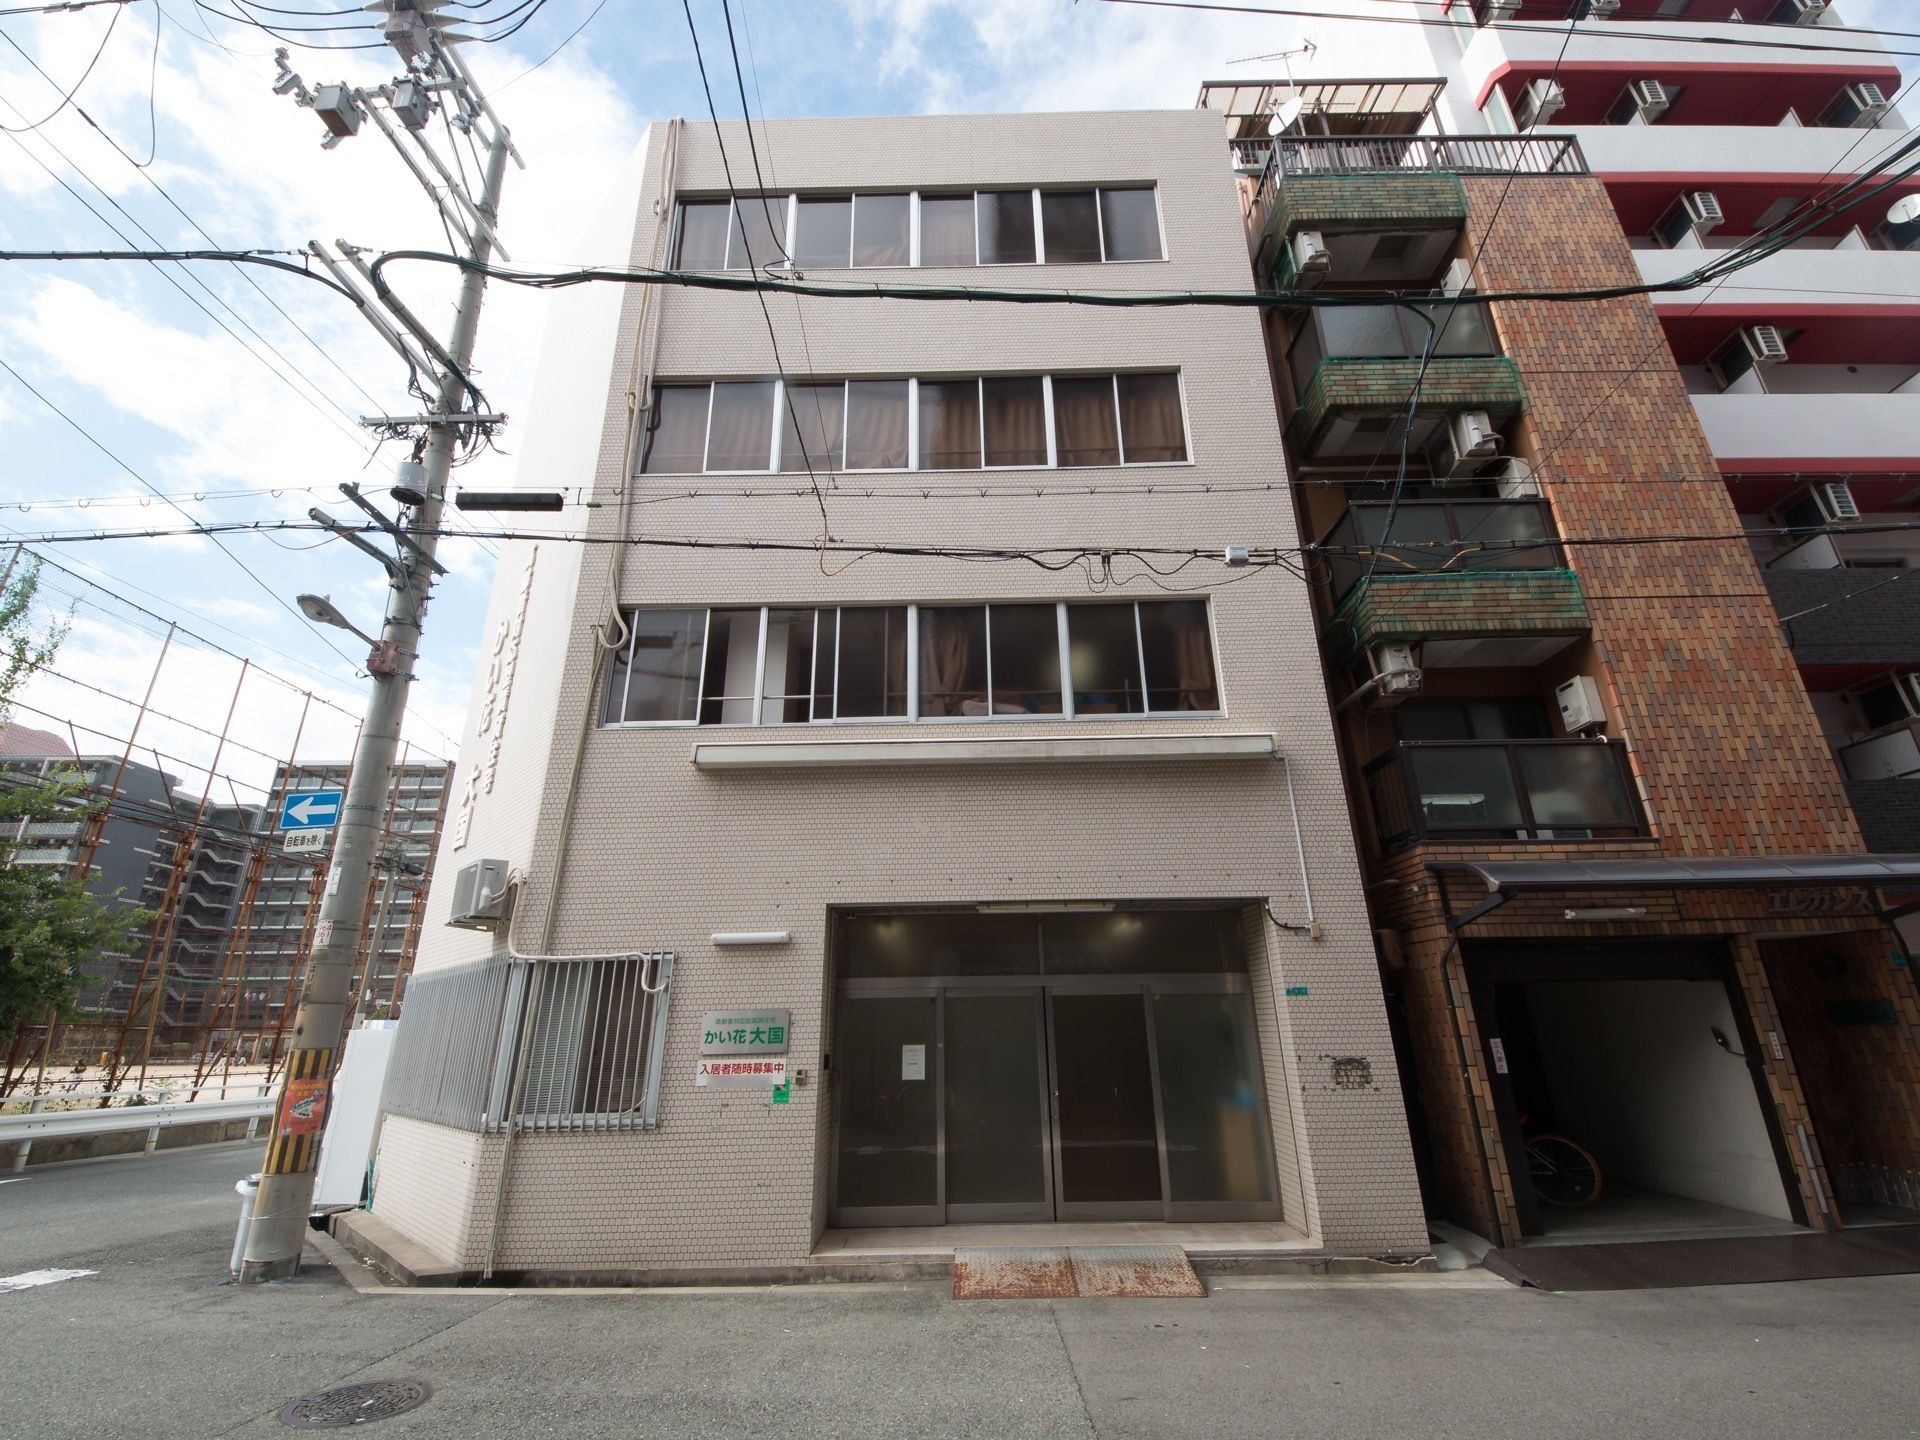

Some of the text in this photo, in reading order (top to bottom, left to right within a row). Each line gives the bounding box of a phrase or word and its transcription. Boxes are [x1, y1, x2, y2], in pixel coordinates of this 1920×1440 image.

[286, 834, 323, 847] 自転車を除く
[1768, 889, 1873, 913] エレガンス
[704, 1026, 784, 1045] かい花大国
[699, 1062, 784, 1075] 入居者随時募集中
